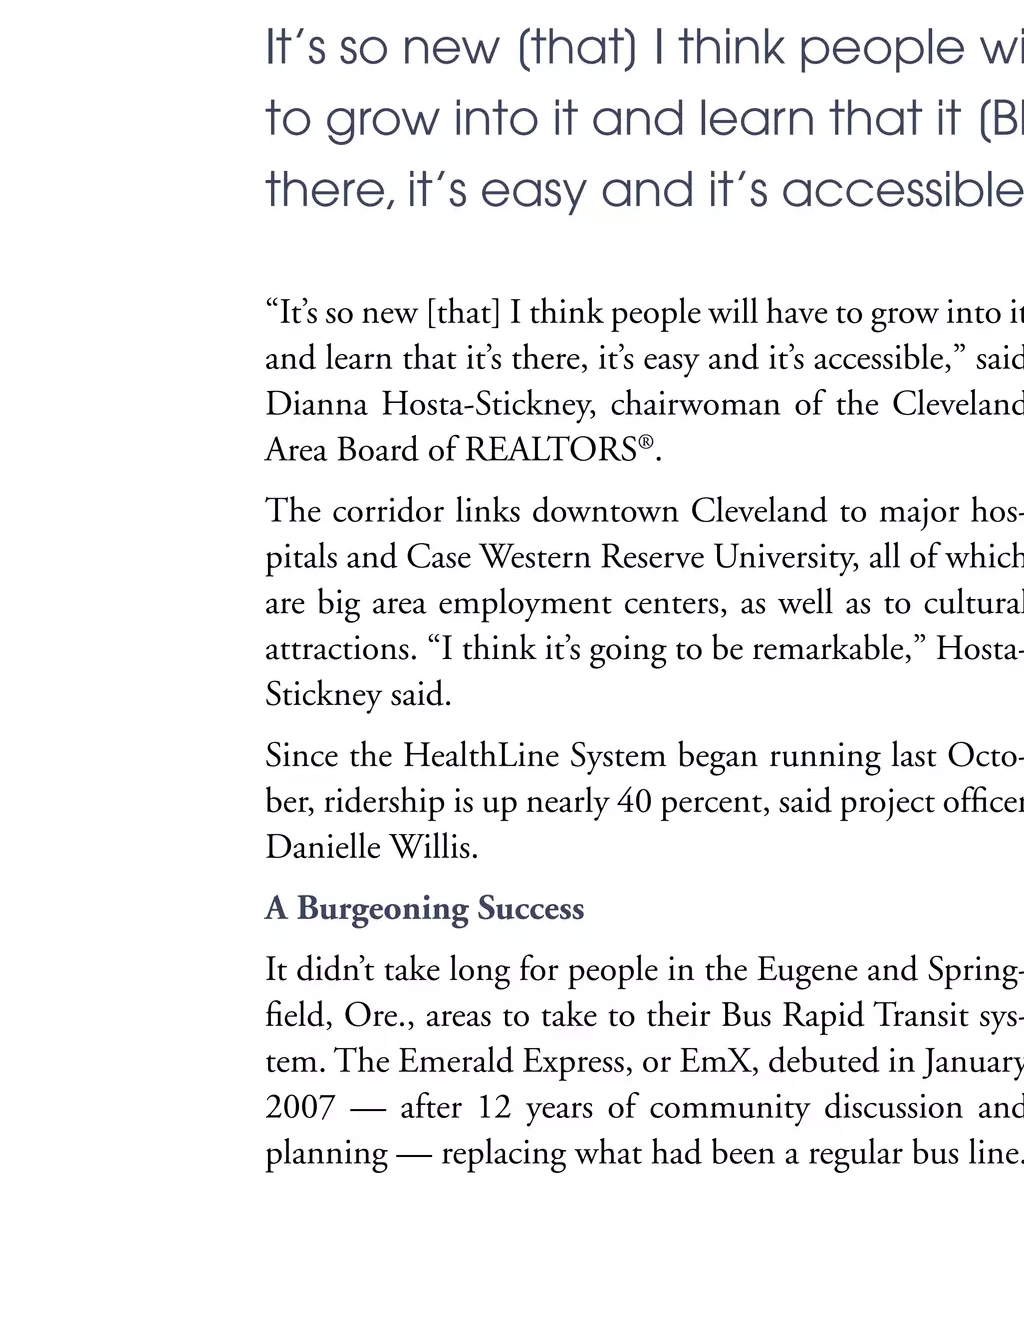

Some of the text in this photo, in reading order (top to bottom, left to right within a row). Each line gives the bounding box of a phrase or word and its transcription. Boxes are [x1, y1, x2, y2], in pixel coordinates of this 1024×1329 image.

[340, 36, 388, 65] so
[404, 36, 501, 65] new
[519, 27, 636, 73] (that)
[656, 27, 662, 65] I
[678, 27, 785, 64] think
[801, 27, 965, 74] people
[265, 99, 311, 136] to
[326, 107, 441, 146] grow
[456, 99, 538, 136] into
[555, 99, 579, 136] it
[592, 99, 683, 136] and
[701, 99, 814, 136] learn
[829, 99, 923, 136] that
[938, 99, 962, 136] it
[265, 170, 395, 210] there,
[481, 178, 588, 216] easy
[602, 170, 693, 208] and
[325, 307, 354, 324] so
[361, 307, 419, 324] new
[428, 296, 499, 329] [that]
[510, 298, 521, 324] I
[529, 296, 605, 324] think
[610, 296, 701, 333] people
[707, 296, 759, 324] will
[766, 296, 828, 324] have
[835, 305, 863, 324] to
[870, 307, 940, 333] grow
[946, 298, 1002, 324] into
[266, 390, 369, 416] Dianna
[382, 388, 596, 424] Hosta-Stickney,
[611, 388, 781, 416] chairwoman
[795, 388, 827, 416] of
[836, 388, 879, 416] the
[263, 435, 328, 462] Area
[337, 434, 420, 462] Board
[428, 434, 461, 462] of
[264, 495, 321, 523] The
[332, 495, 445, 523] corridor
[455, 495, 521, 523] links
[532, 495, 679, 523] downtown
[691, 495, 828, 523] Cleveland
[839, 504, 867, 523] to
[879, 497, 960, 532] major
[265, 597, 305, 615] are
[317, 587, 361, 624] big
[372, 597, 427, 615] area
[438, 587, 613, 623] employment
[624, 596, 727, 618] centers,
[740, 597, 766, 615] as
[777, 587, 833, 615] well
[845, 597, 871, 615] as
[884, 596, 911, 615] to
[265, 678, 451, 715] Stickney said.
[265, 741, 339, 768] Since
[349, 740, 393, 768] the
[403, 740, 560, 768] HealthLine
[570, 741, 667, 776] System
[678, 740, 759, 777] began
[769, 741, 882, 777] running
[891, 740, 937, 768] last
[266, 831, 478, 859] Danielle Willis.
[263, 894, 585, 929] A Burgeoning Success
[265, 1054, 326, 1073] tem.
[333, 1045, 390, 1073] The
[398, 1045, 514, 1073] Emerald
[522, 1047, 633, 1082] Express,
[642, 1056, 672, 1073] or
[679, 1047, 759, 1077] EmX,
[768, 1045, 880, 1073] debuted
[888, 1047, 916, 1073] in
